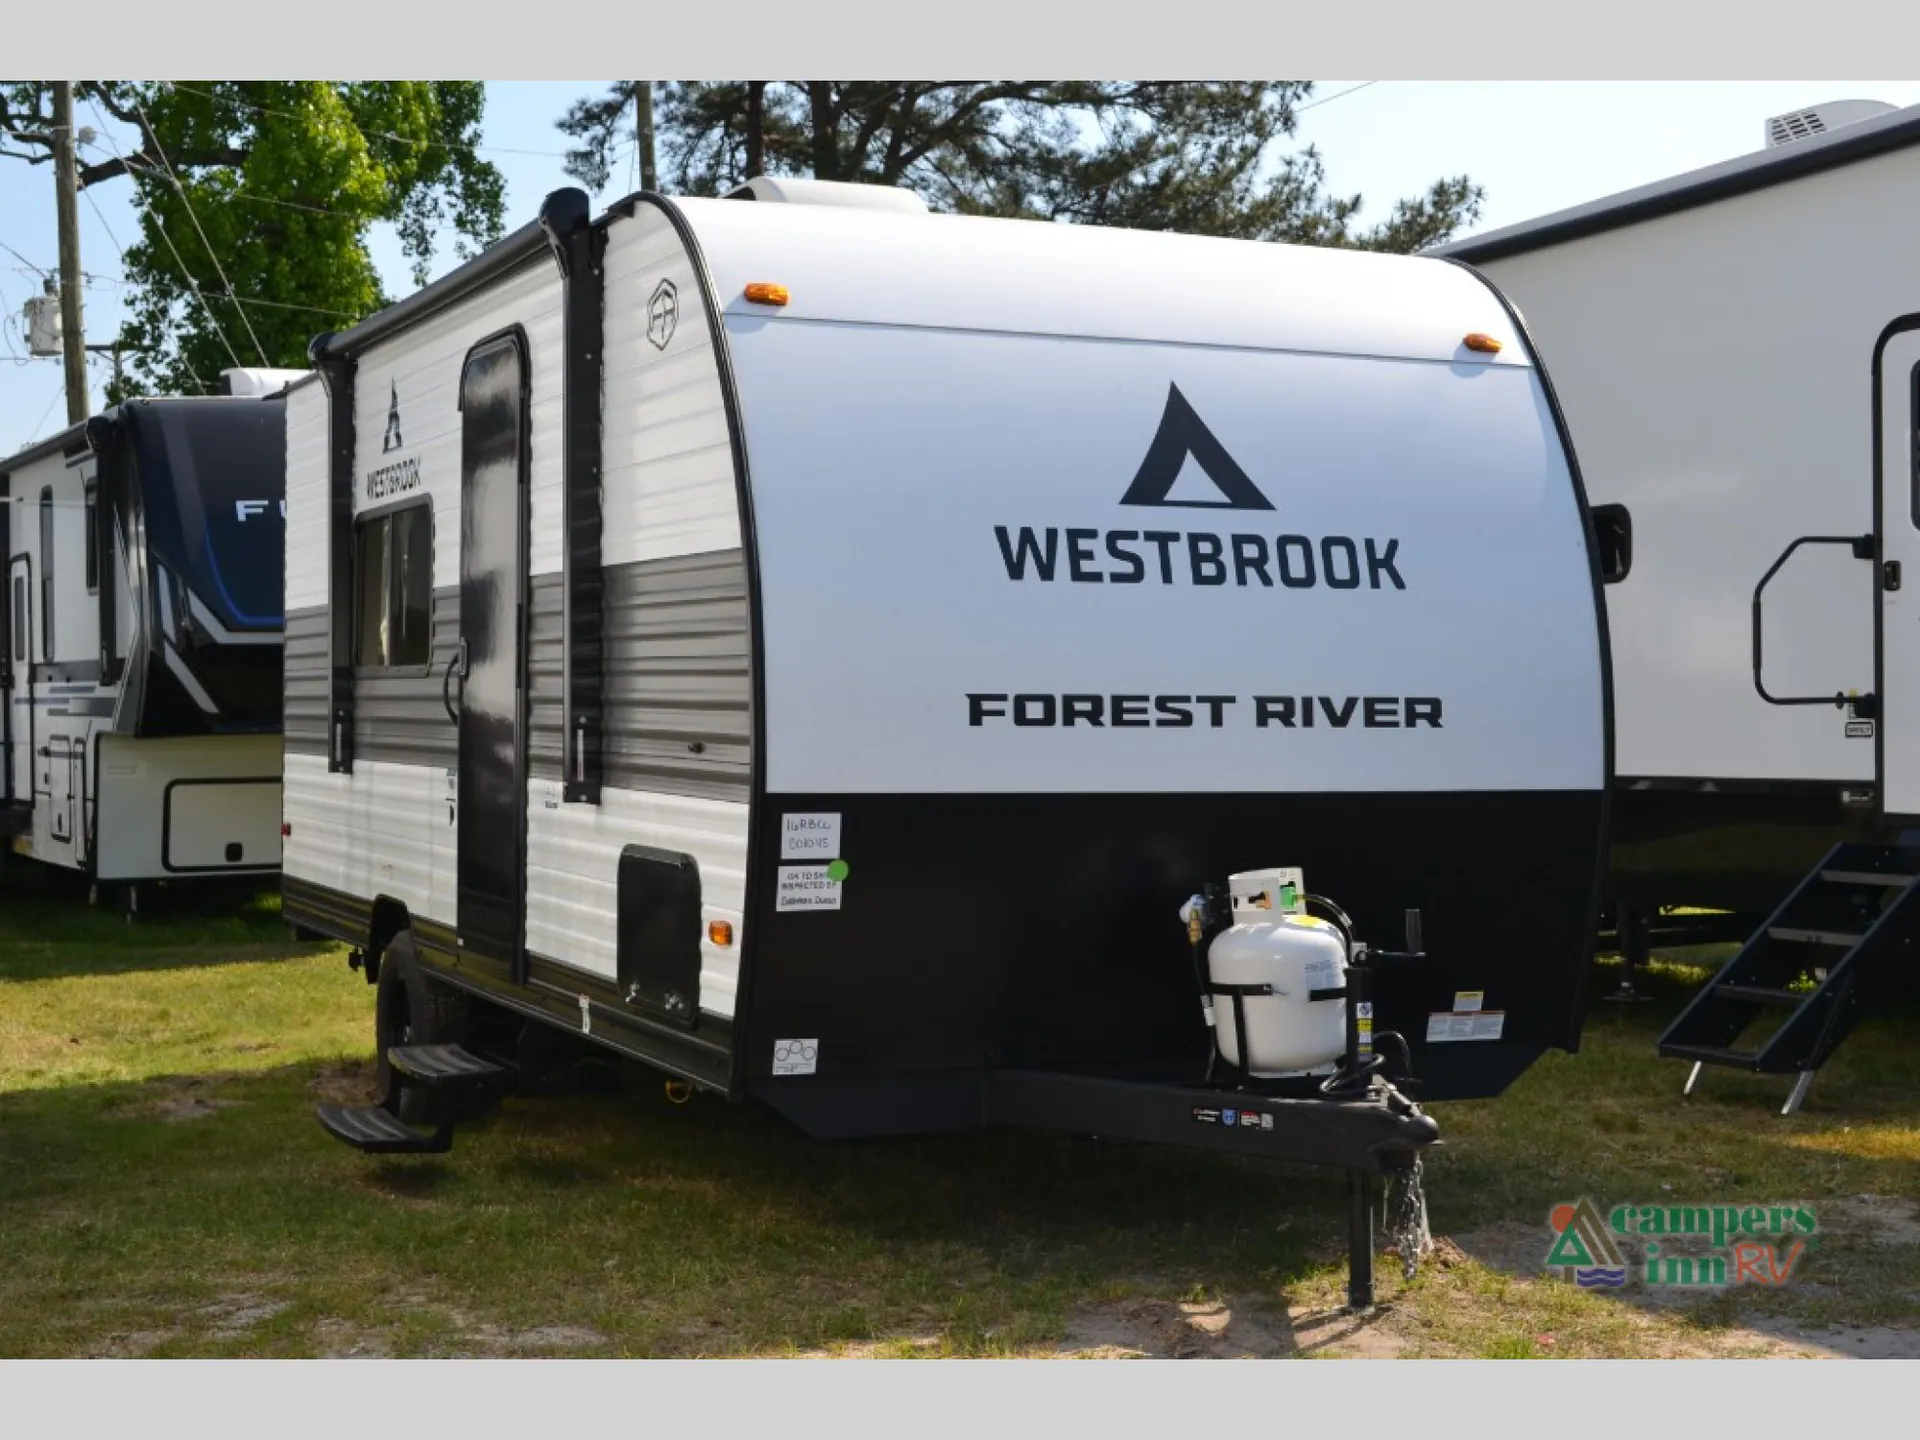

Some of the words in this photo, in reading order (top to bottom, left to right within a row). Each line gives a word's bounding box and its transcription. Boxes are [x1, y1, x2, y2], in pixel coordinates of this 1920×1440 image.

[367, 455, 421, 499] WESTBROOK
[994, 525, 1406, 590] WESTBROOK
[964, 693, 1236, 727] FOREST
[1252, 695, 1444, 728] RIVER
